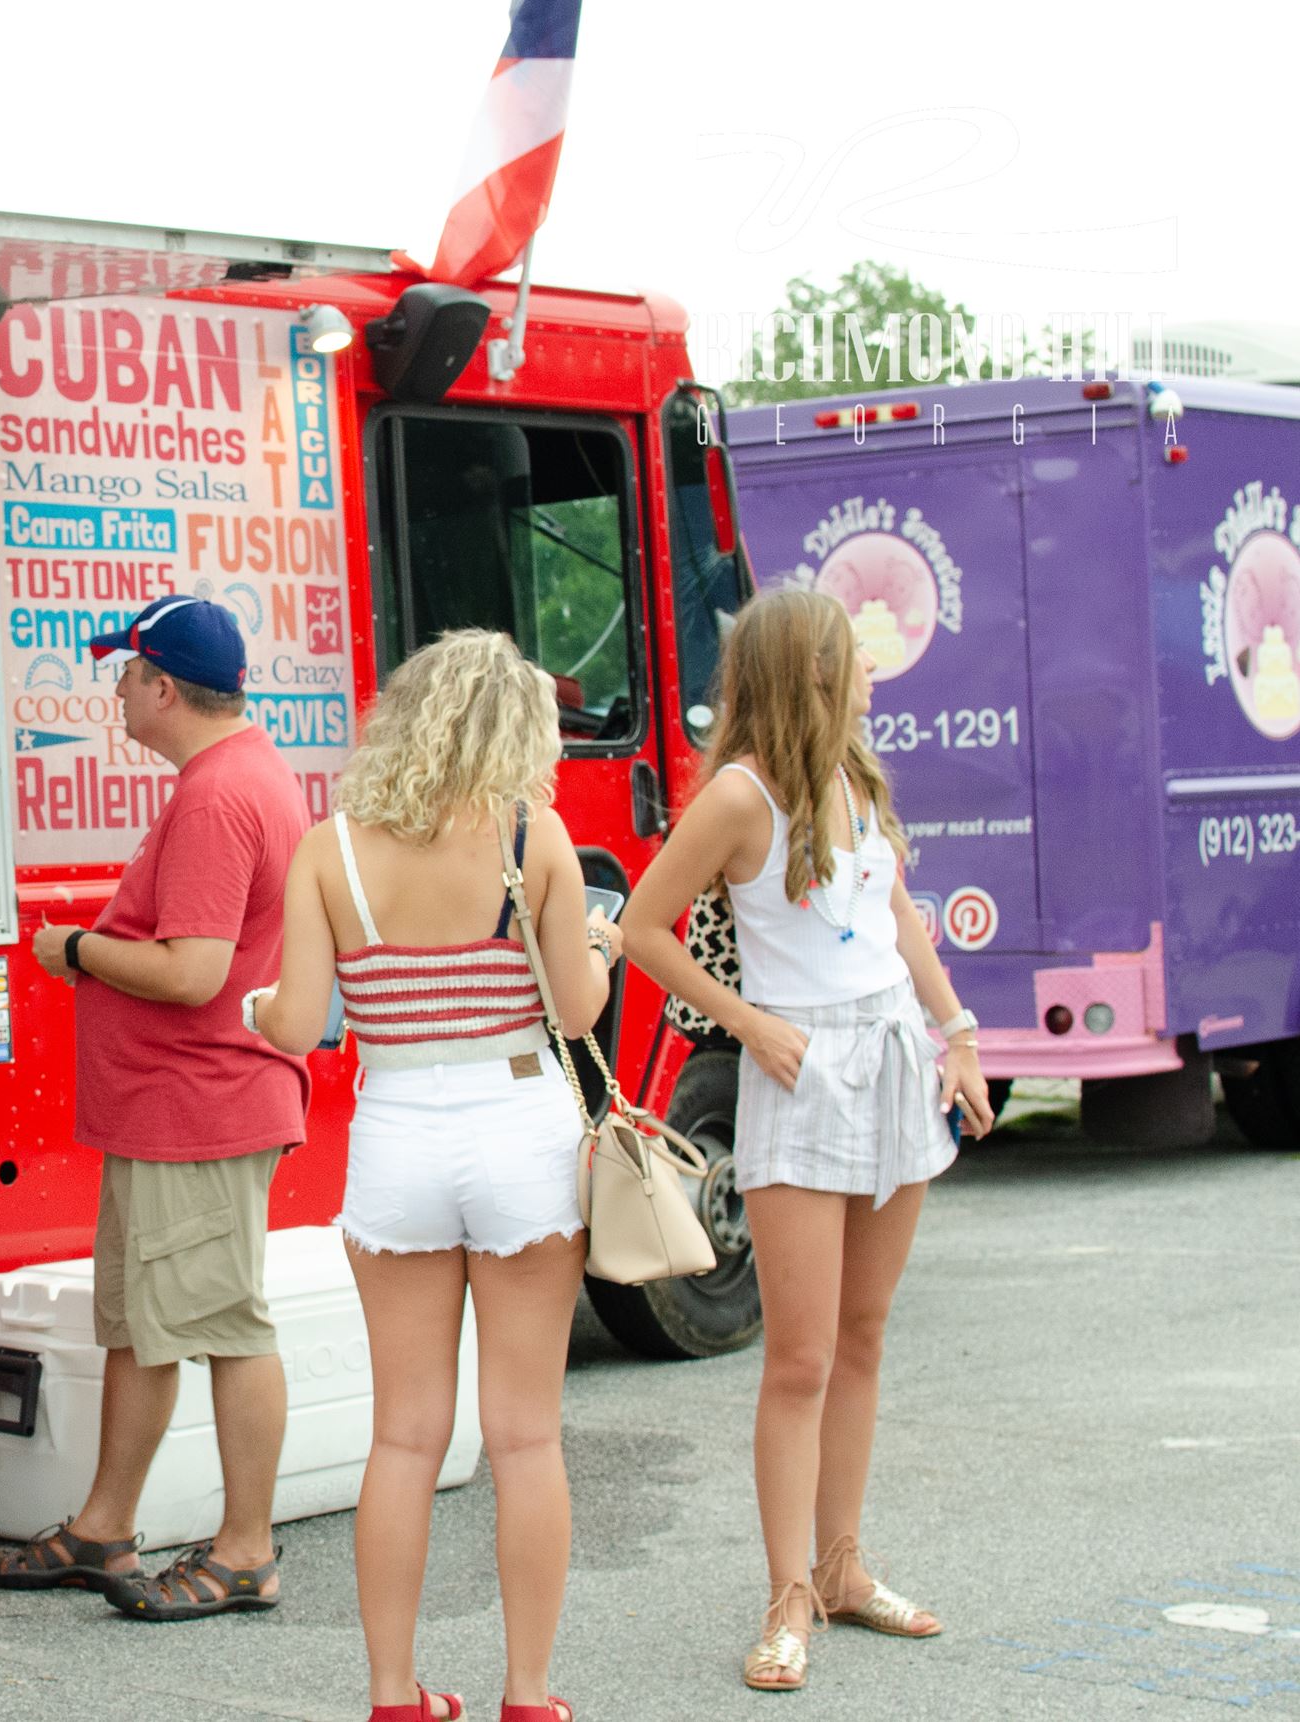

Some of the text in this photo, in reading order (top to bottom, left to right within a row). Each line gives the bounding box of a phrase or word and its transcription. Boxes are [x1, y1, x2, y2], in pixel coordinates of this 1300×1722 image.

[0, 406, 246, 464] sandwiches
[295, 331, 329, 503] BORICUA
[3, 461, 248, 501] Mango Salsa
[10, 506, 171, 548] Carne Frita
[187, 513, 339, 576] FUSION
[6, 558, 176, 601] TOSTONES
[272, 654, 344, 690] Crazy
[987, 815, 1033, 835] event
[1198, 815, 1255, 868] (912)
